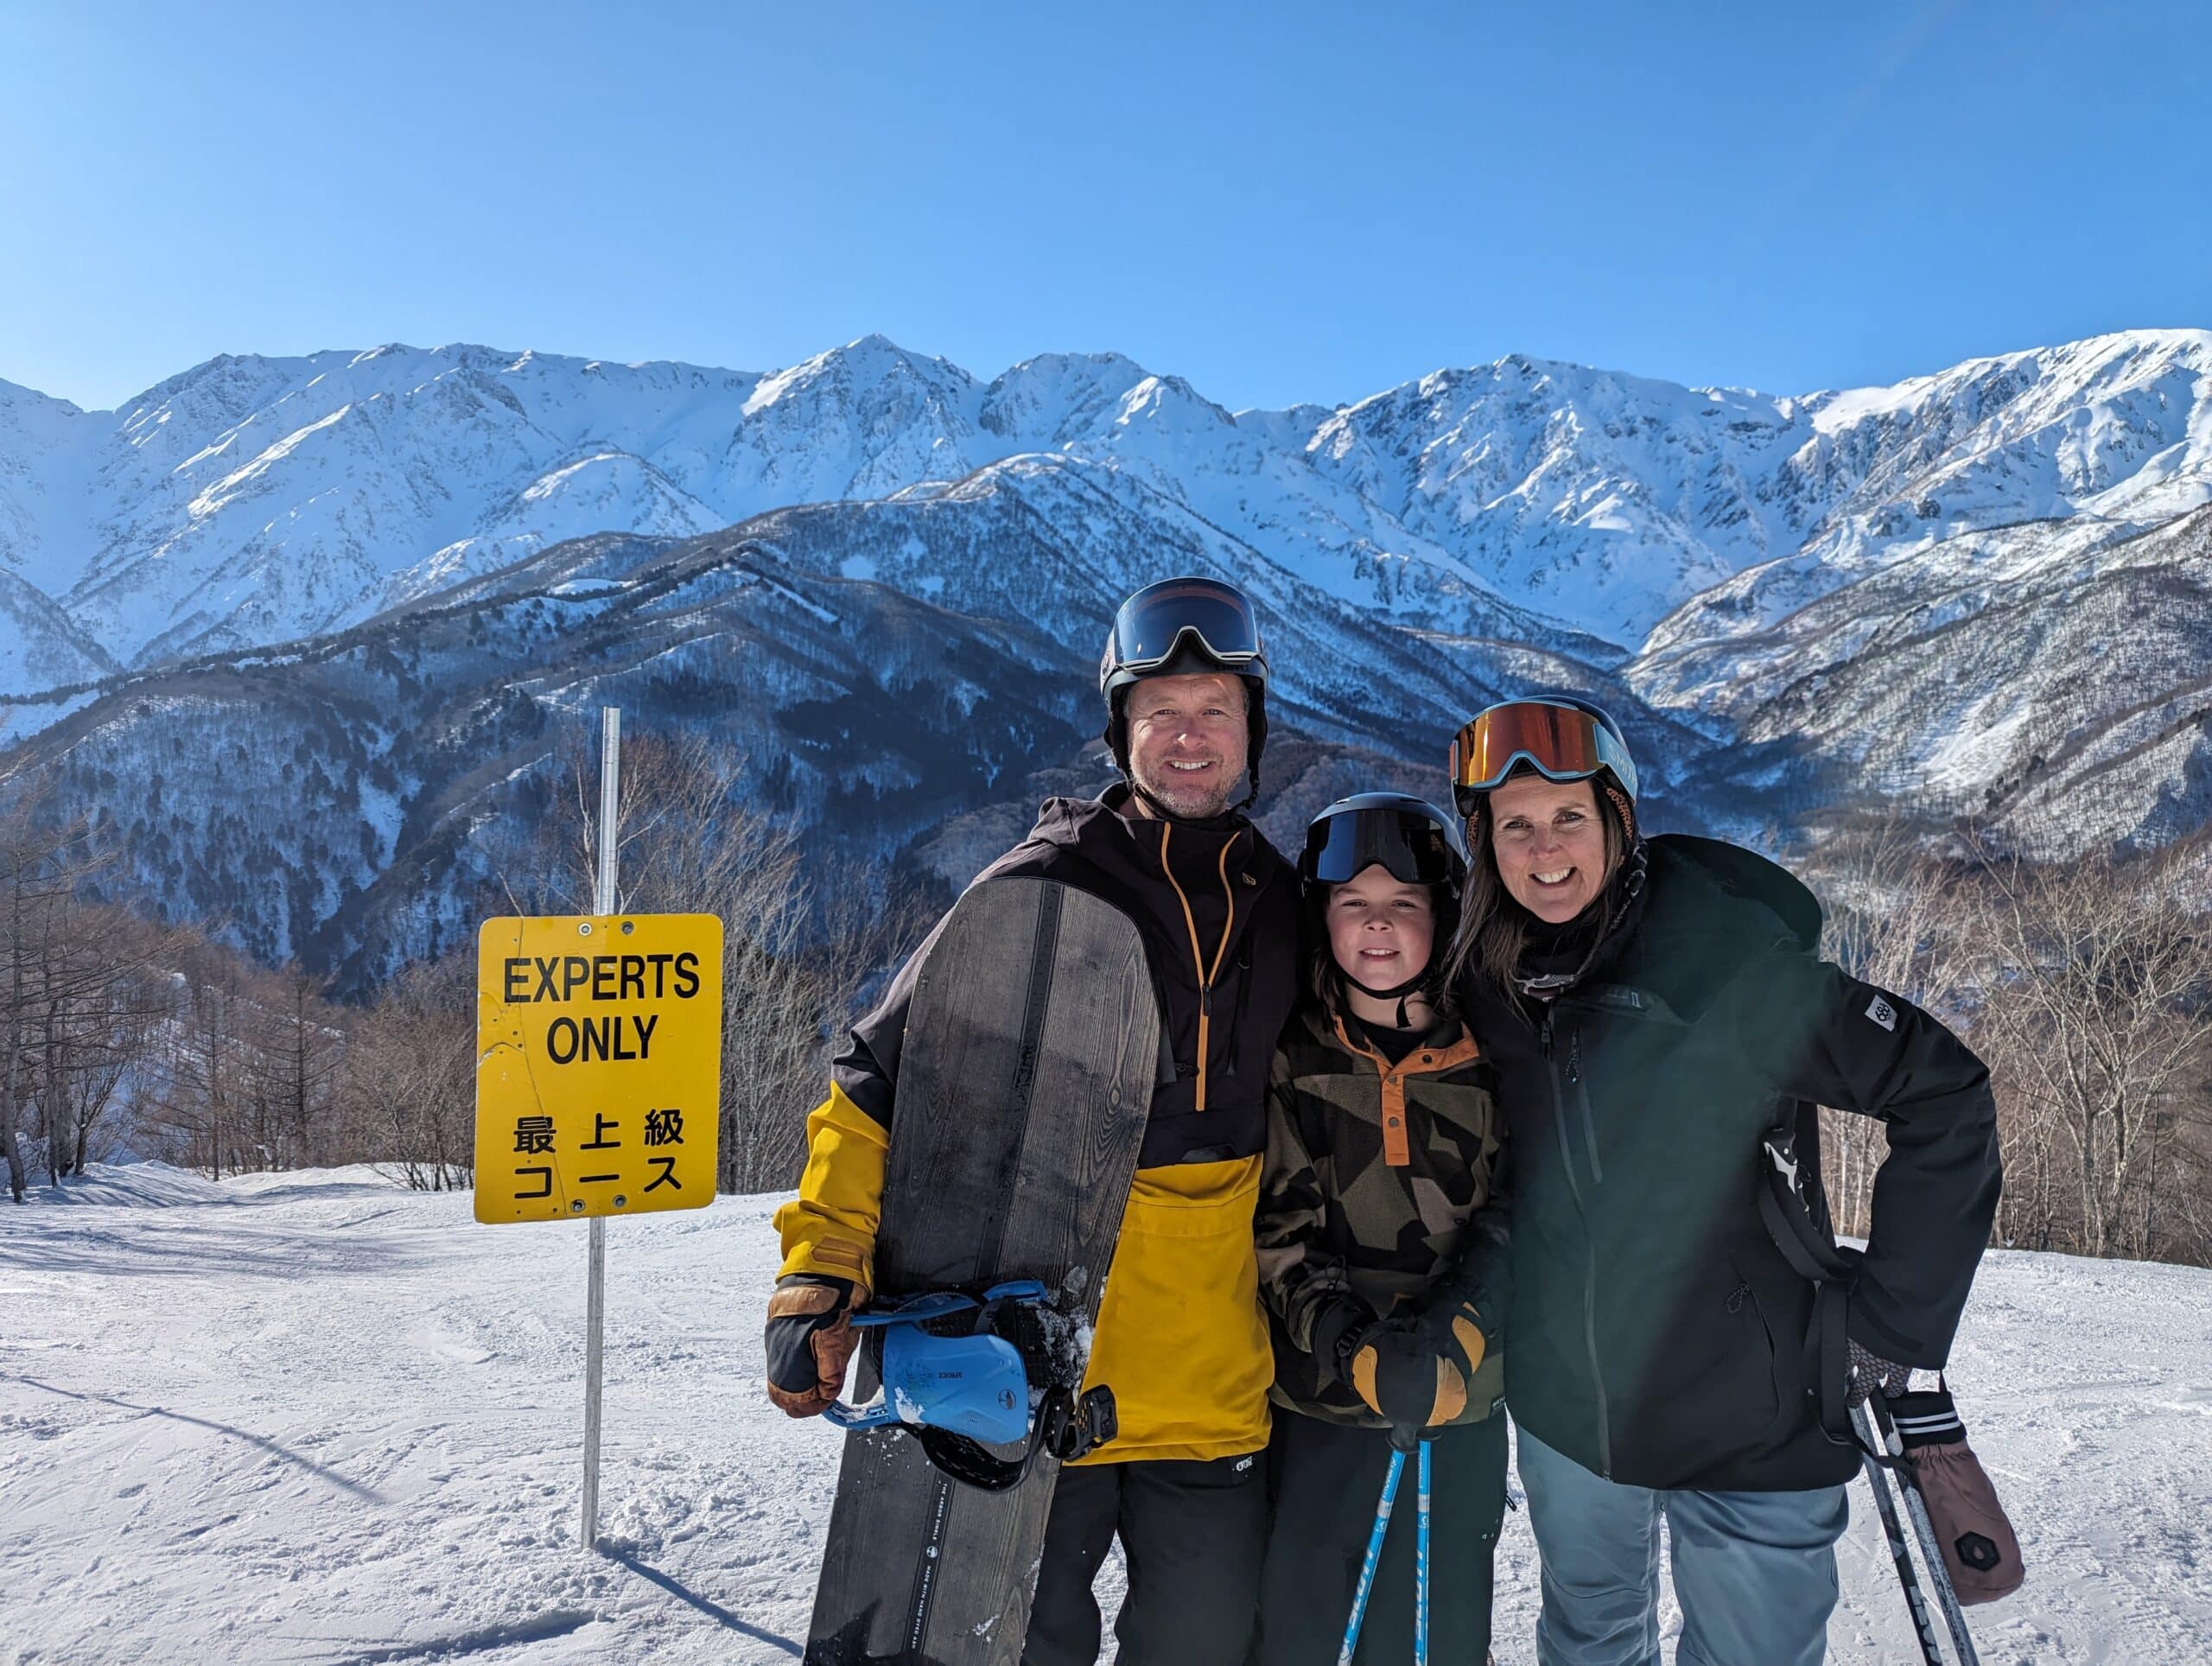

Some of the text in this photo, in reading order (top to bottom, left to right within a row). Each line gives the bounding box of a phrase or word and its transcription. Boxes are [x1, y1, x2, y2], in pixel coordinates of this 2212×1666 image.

[1608, 743, 1637, 784] SMITH
[504, 951, 700, 1004] EXPERTS
[546, 1014, 659, 1065] ONLY
[512, 1108, 685, 1155] 最上級
[513, 1156, 683, 1199] コース
